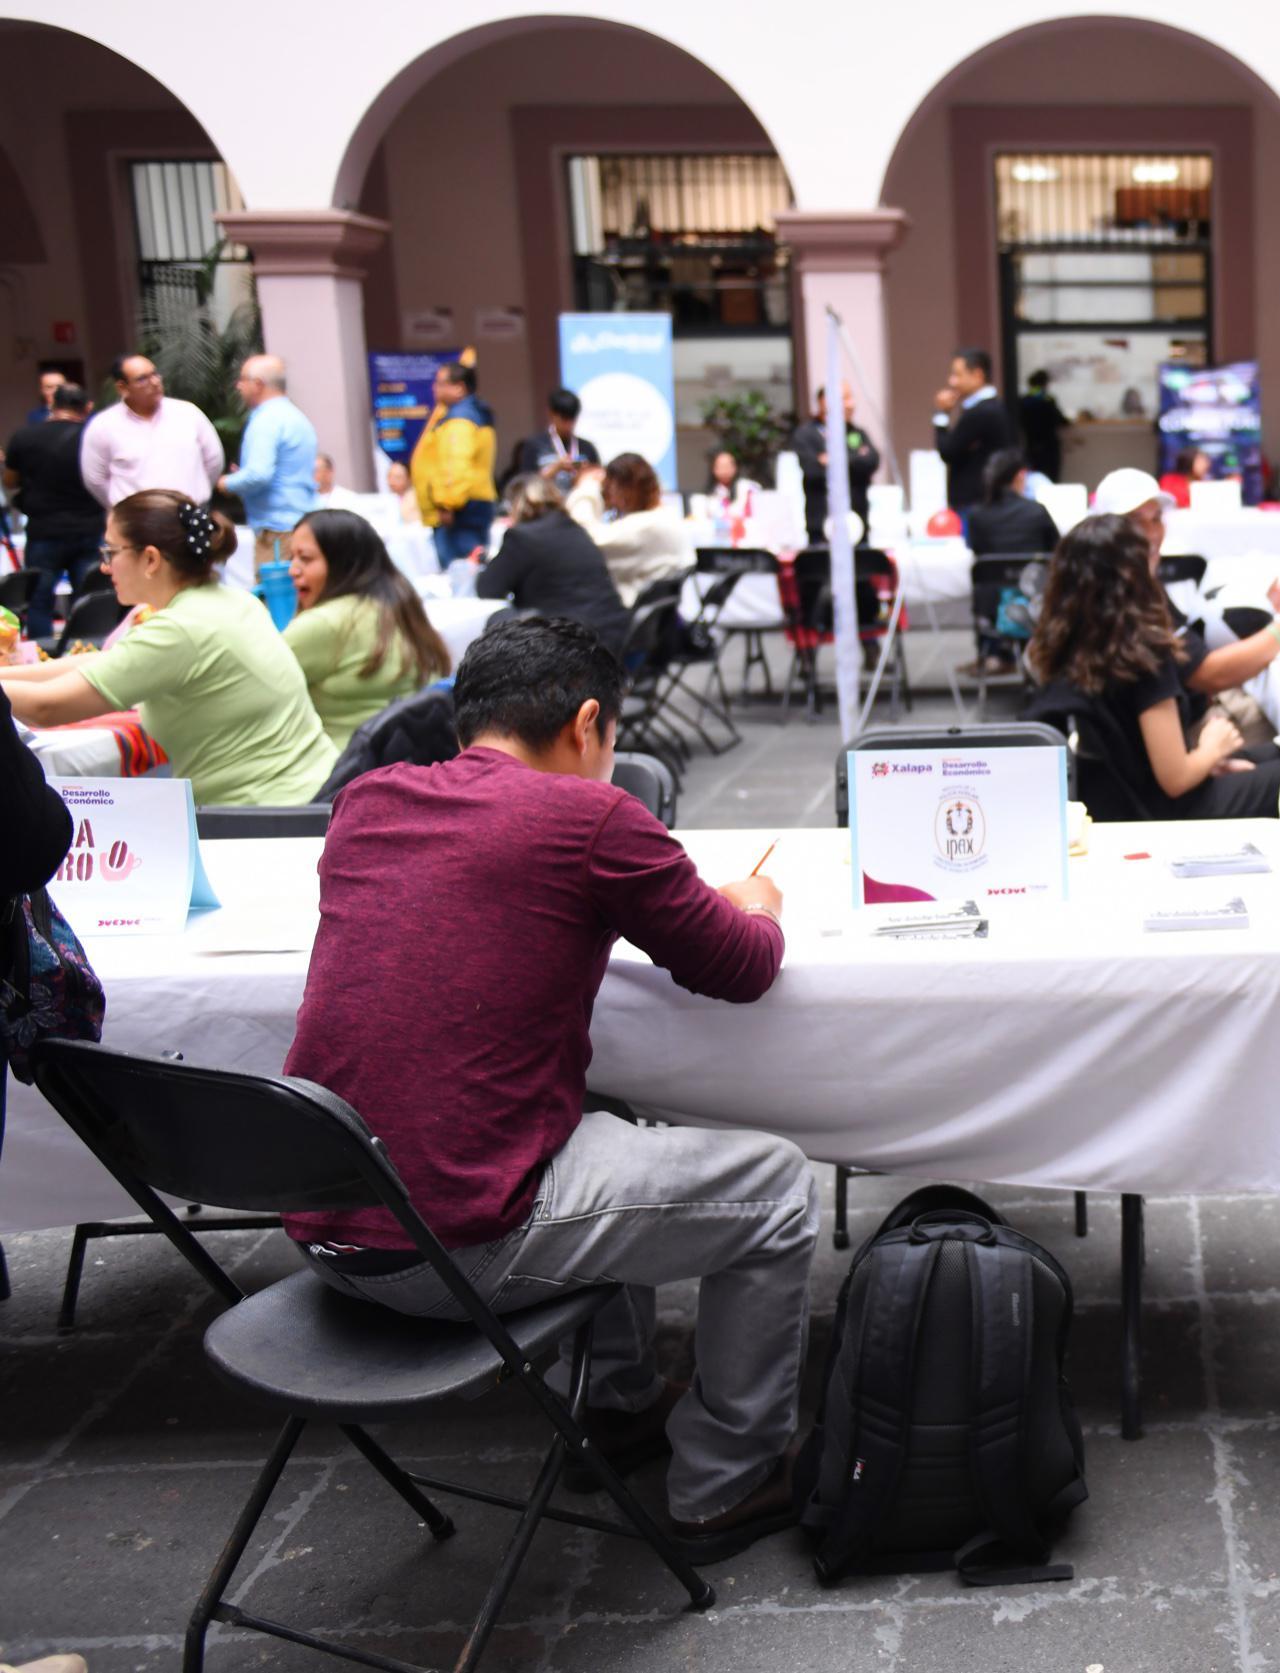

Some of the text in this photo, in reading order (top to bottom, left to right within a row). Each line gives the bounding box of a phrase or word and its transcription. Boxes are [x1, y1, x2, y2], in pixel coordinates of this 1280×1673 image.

[942, 760, 987, 769] Desarrollo
[892, 763, 933, 775] Xalapa
[942, 768, 991, 776] Económico
[62, 789, 110, 797] Desarrollo
